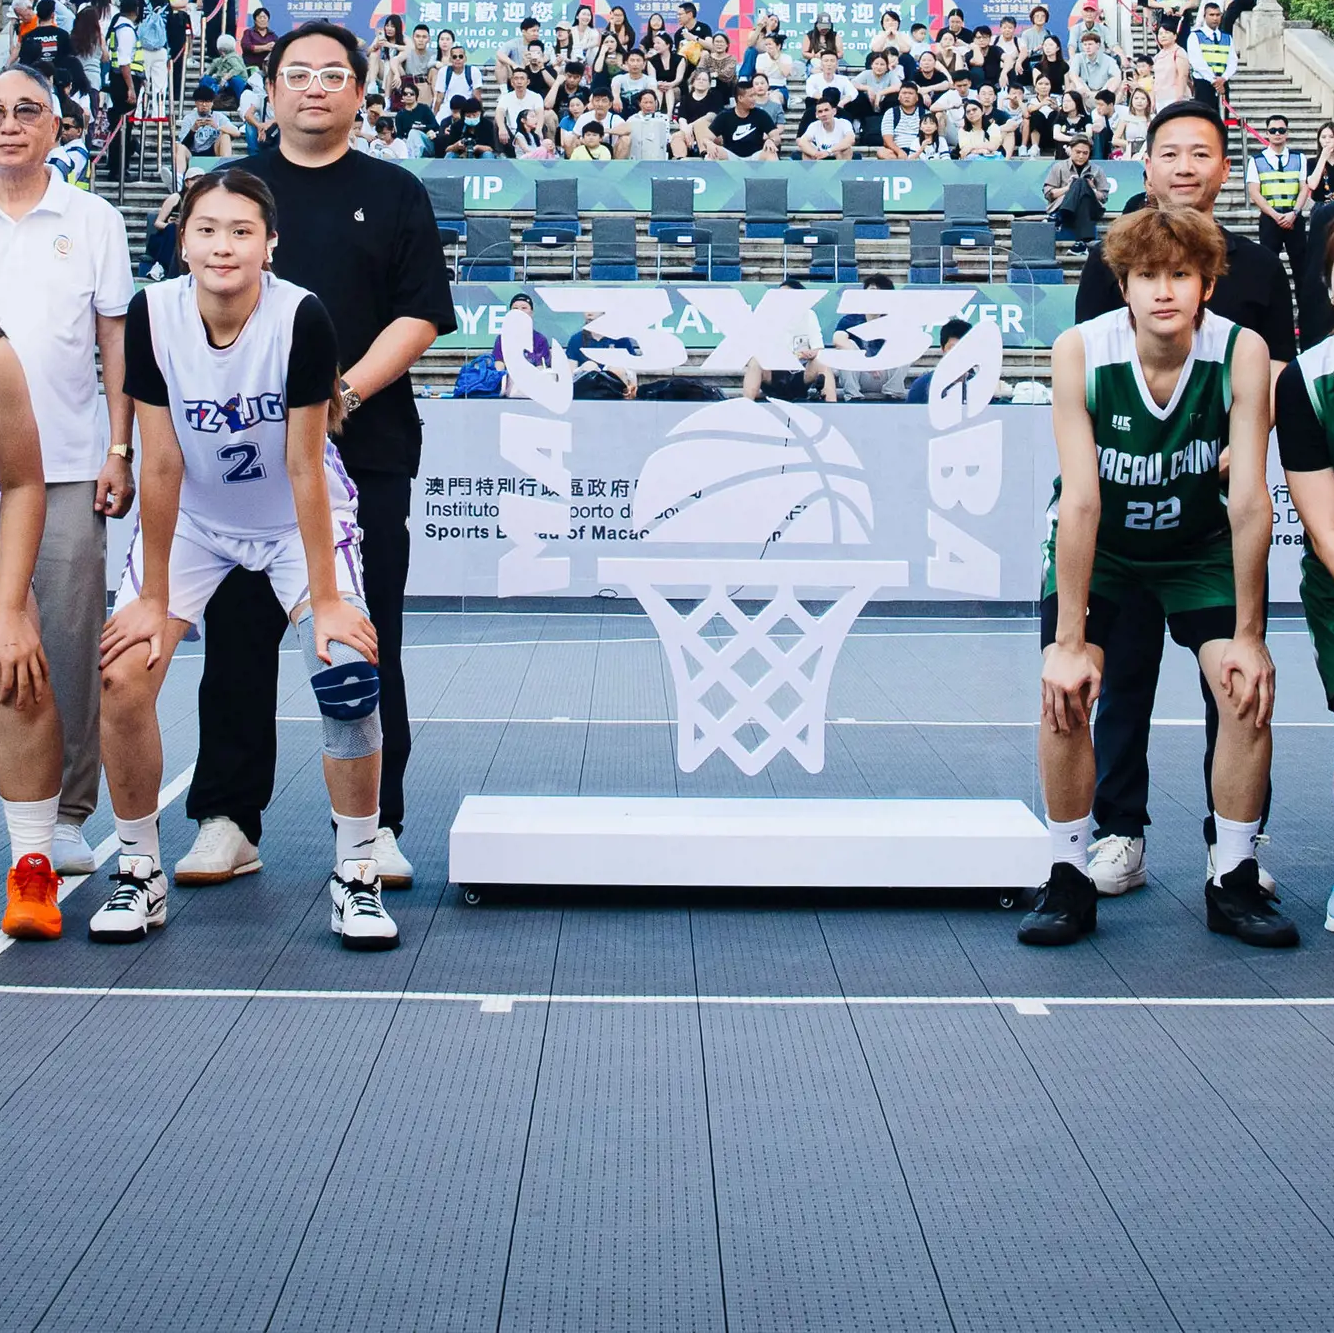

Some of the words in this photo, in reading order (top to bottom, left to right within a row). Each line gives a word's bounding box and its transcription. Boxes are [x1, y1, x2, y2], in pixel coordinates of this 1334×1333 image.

[216, 440, 268, 485] 2
[425, 500, 500, 517] Instituto
[1125, 496, 1181, 530] 22
[425, 524, 489, 542] Sports
